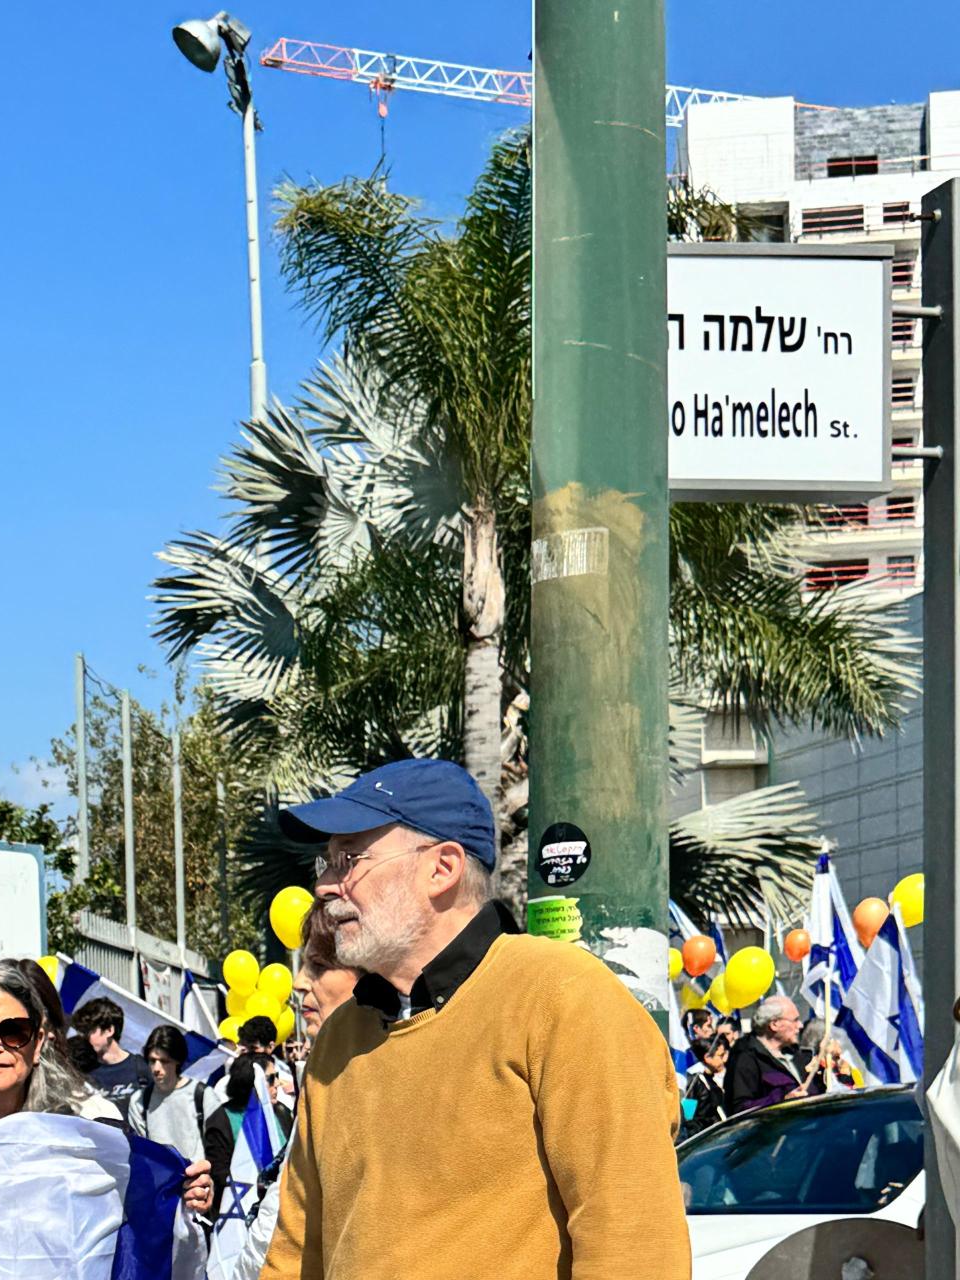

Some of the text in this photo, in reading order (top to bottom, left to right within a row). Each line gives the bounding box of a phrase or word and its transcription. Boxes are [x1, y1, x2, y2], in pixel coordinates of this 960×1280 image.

[703, 305, 807, 353] שלמה
[817, 326, 852, 355] רח'
[694, 387, 818, 438] Ha'melech
[830, 420, 858, 438] St.
